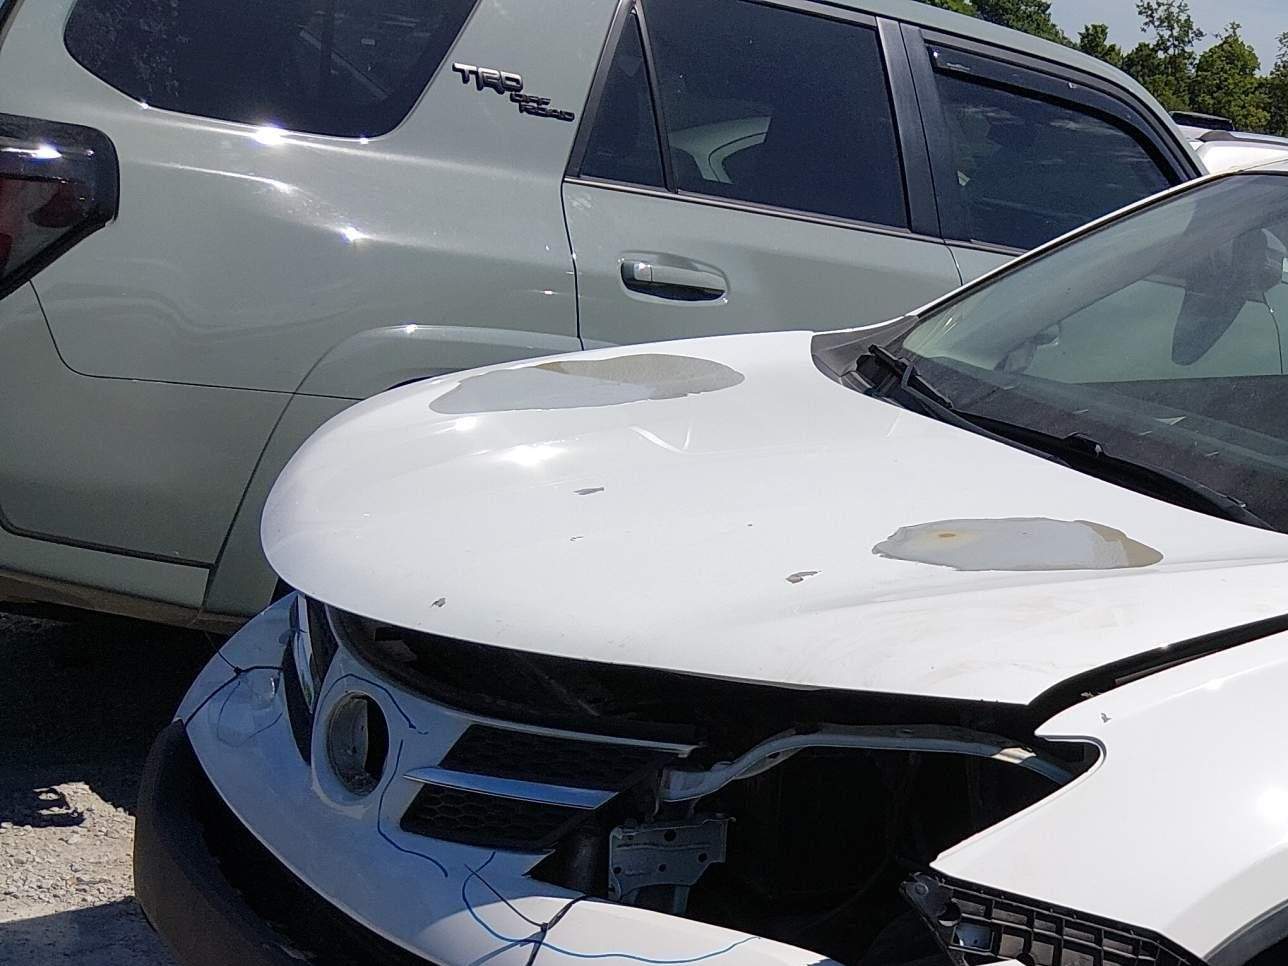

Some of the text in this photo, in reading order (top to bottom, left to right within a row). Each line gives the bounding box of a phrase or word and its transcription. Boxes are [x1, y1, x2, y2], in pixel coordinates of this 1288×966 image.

[452, 62, 524, 95] TRD
[509, 91, 551, 107] OFF
[518, 102, 575, 122] ROAD
